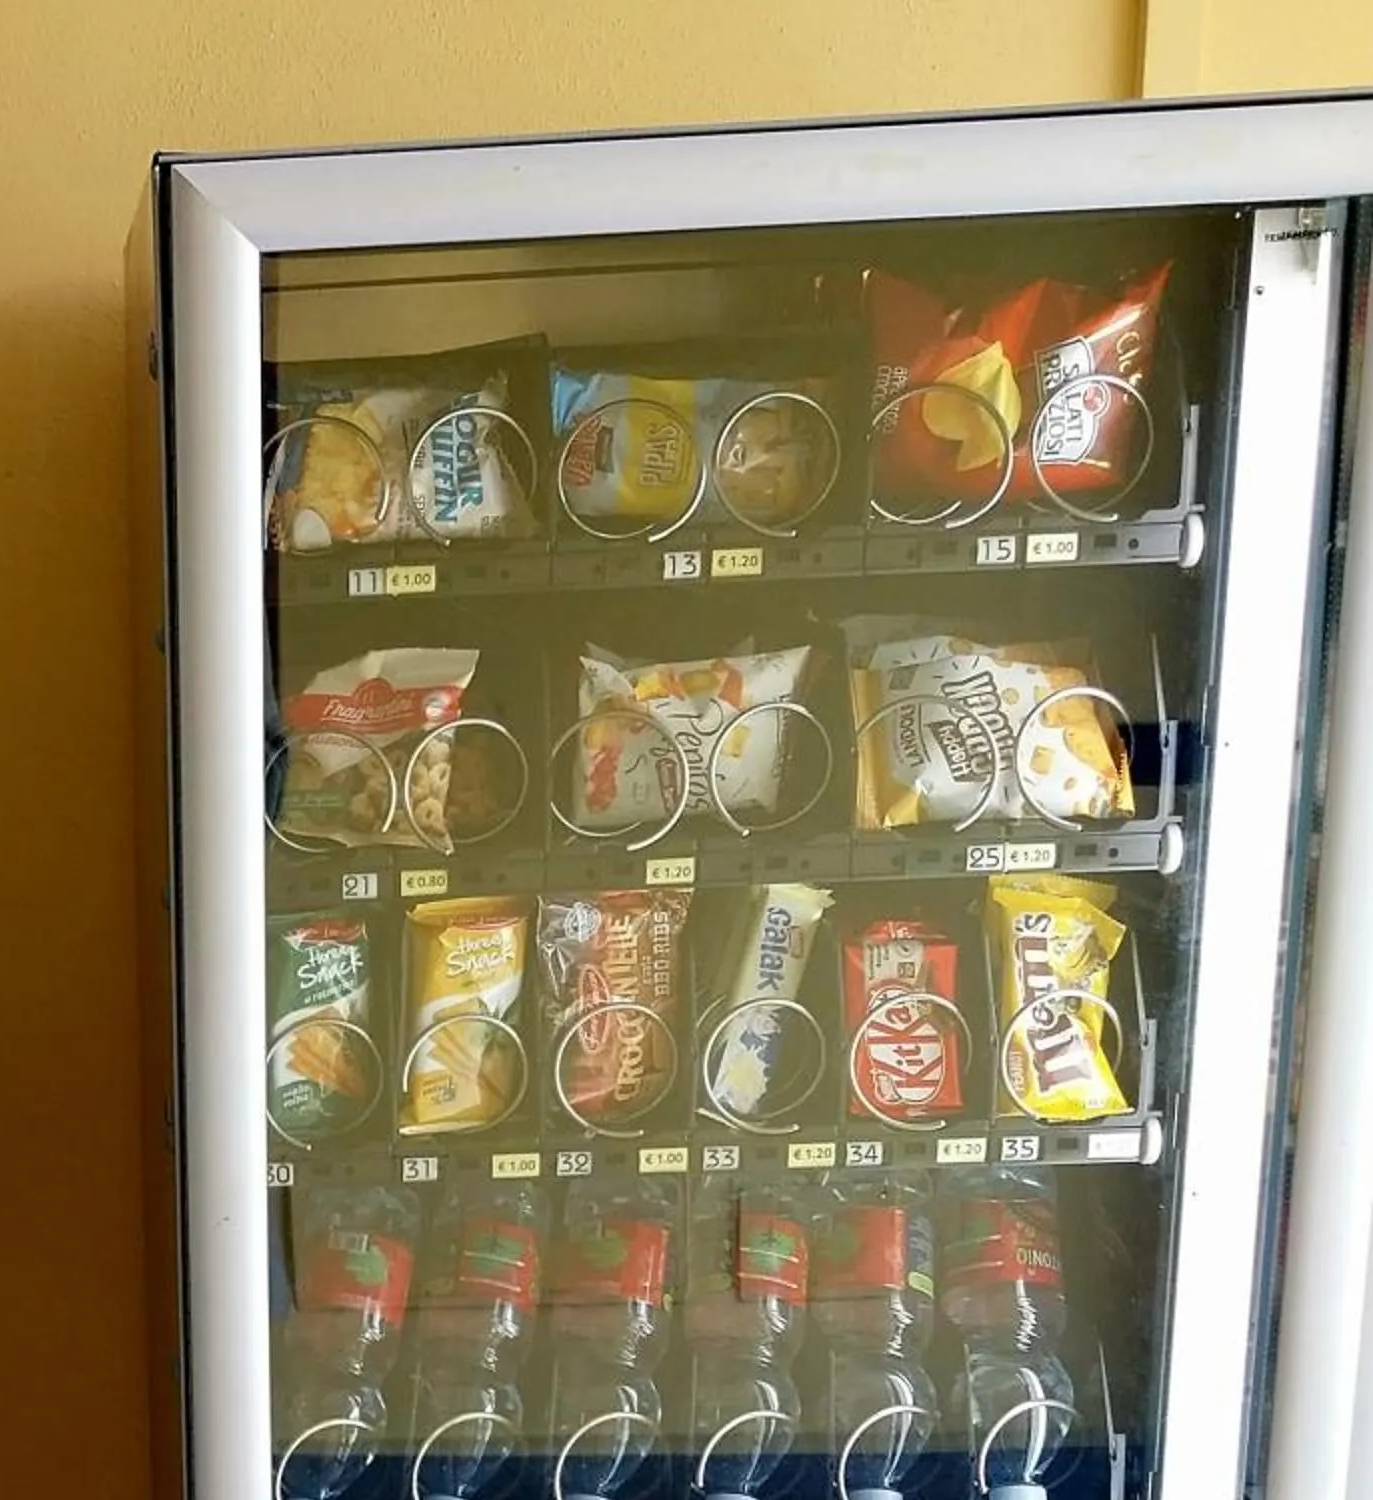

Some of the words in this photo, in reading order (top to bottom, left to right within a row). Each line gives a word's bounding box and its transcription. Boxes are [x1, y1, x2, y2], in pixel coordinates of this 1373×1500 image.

[1042, 354, 1066, 457] PRZIOSI
[640, 422, 678, 488] PIPAS
[981, 538, 1011, 561] 15
[669, 554, 697, 576] 13
[355, 571, 377, 593] 11
[937, 725, 971, 783] Happy
[969, 848, 1000, 868] 25
[344, 876, 368, 897] 21
[652, 911, 670, 959] RIBS
[756, 906, 792, 991] Galak
[866, 998, 944, 1098] KitKa
[708, 1149, 737, 1168] 33
[849, 1144, 878, 1163] 34
[1005, 1139, 1035, 1158] 35
[406, 1159, 430, 1179] 31
[560, 1153, 588, 1172] 32
